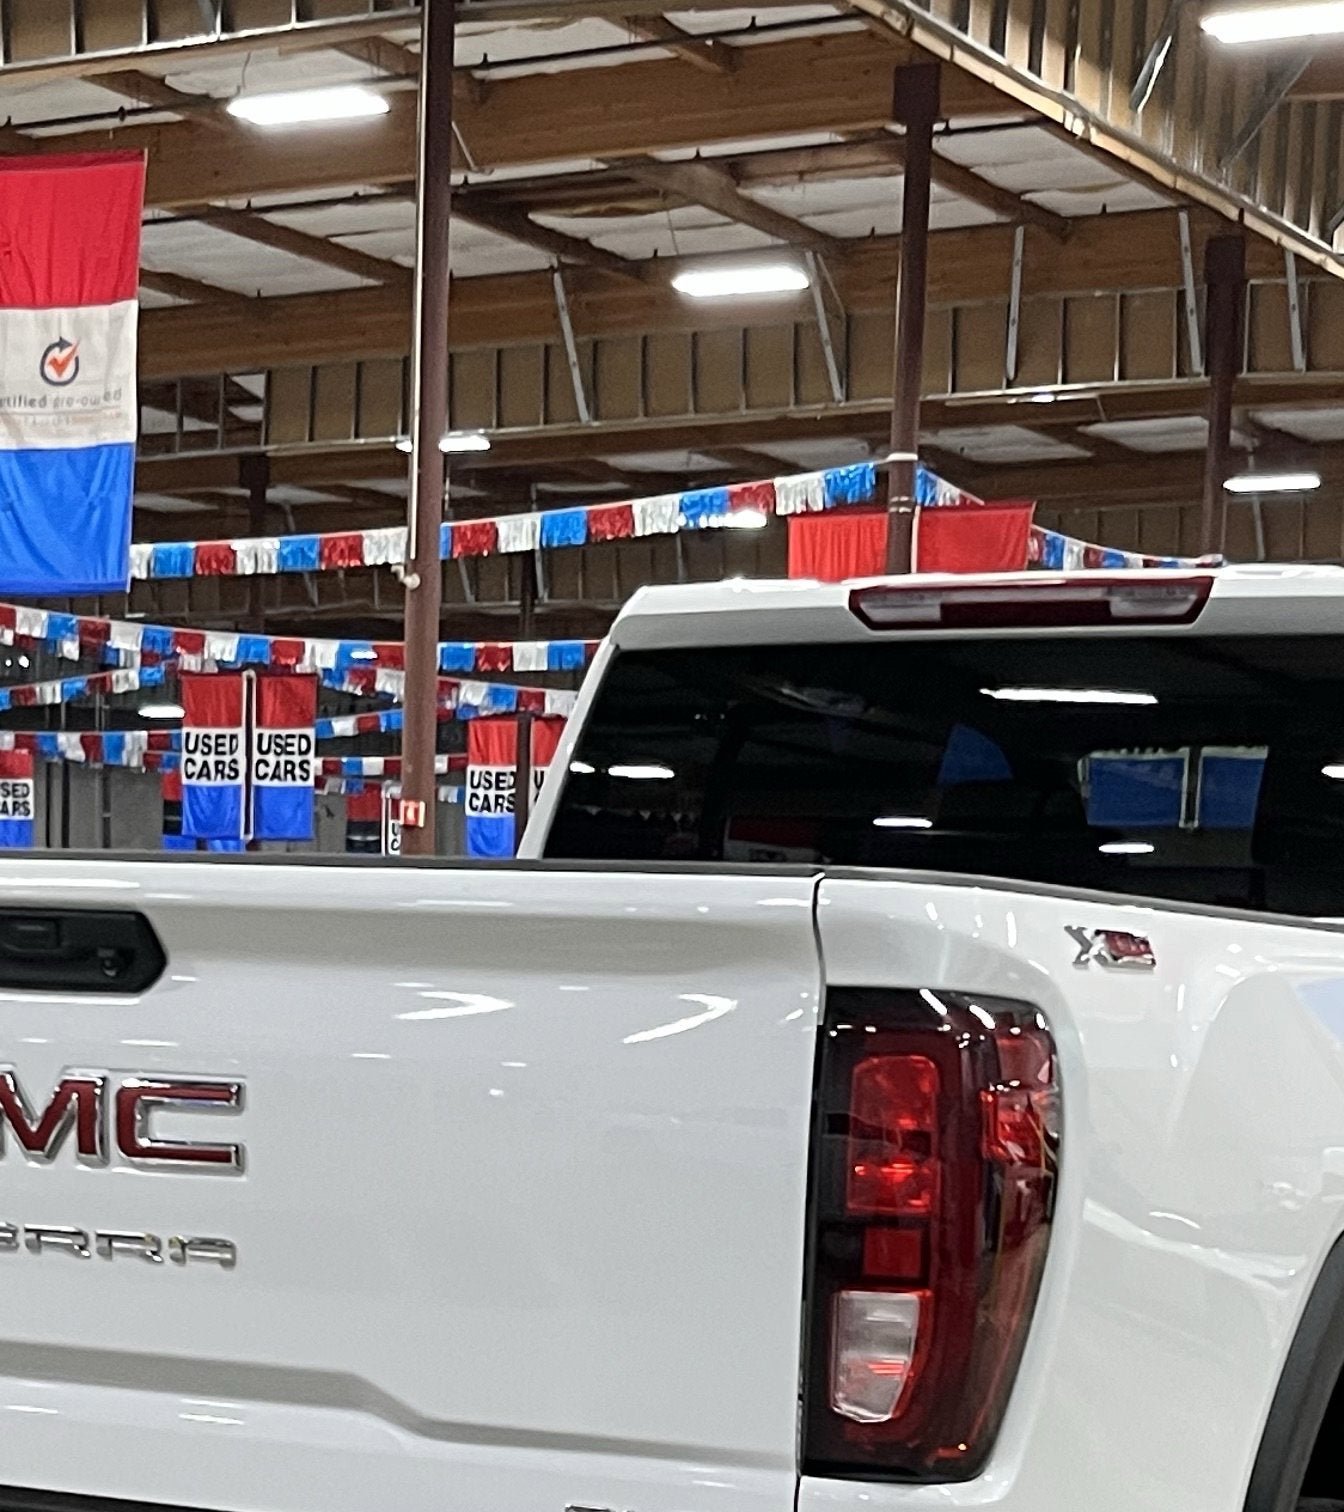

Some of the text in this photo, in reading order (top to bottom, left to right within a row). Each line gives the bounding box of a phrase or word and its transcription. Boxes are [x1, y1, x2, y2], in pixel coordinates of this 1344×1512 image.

[185, 732, 238, 756] USED
[257, 733, 311, 756] USED
[184, 758, 239, 781] CARS
[255, 758, 310, 782] CARS
[470, 770, 517, 791] USED
[469, 792, 516, 814] CARS
